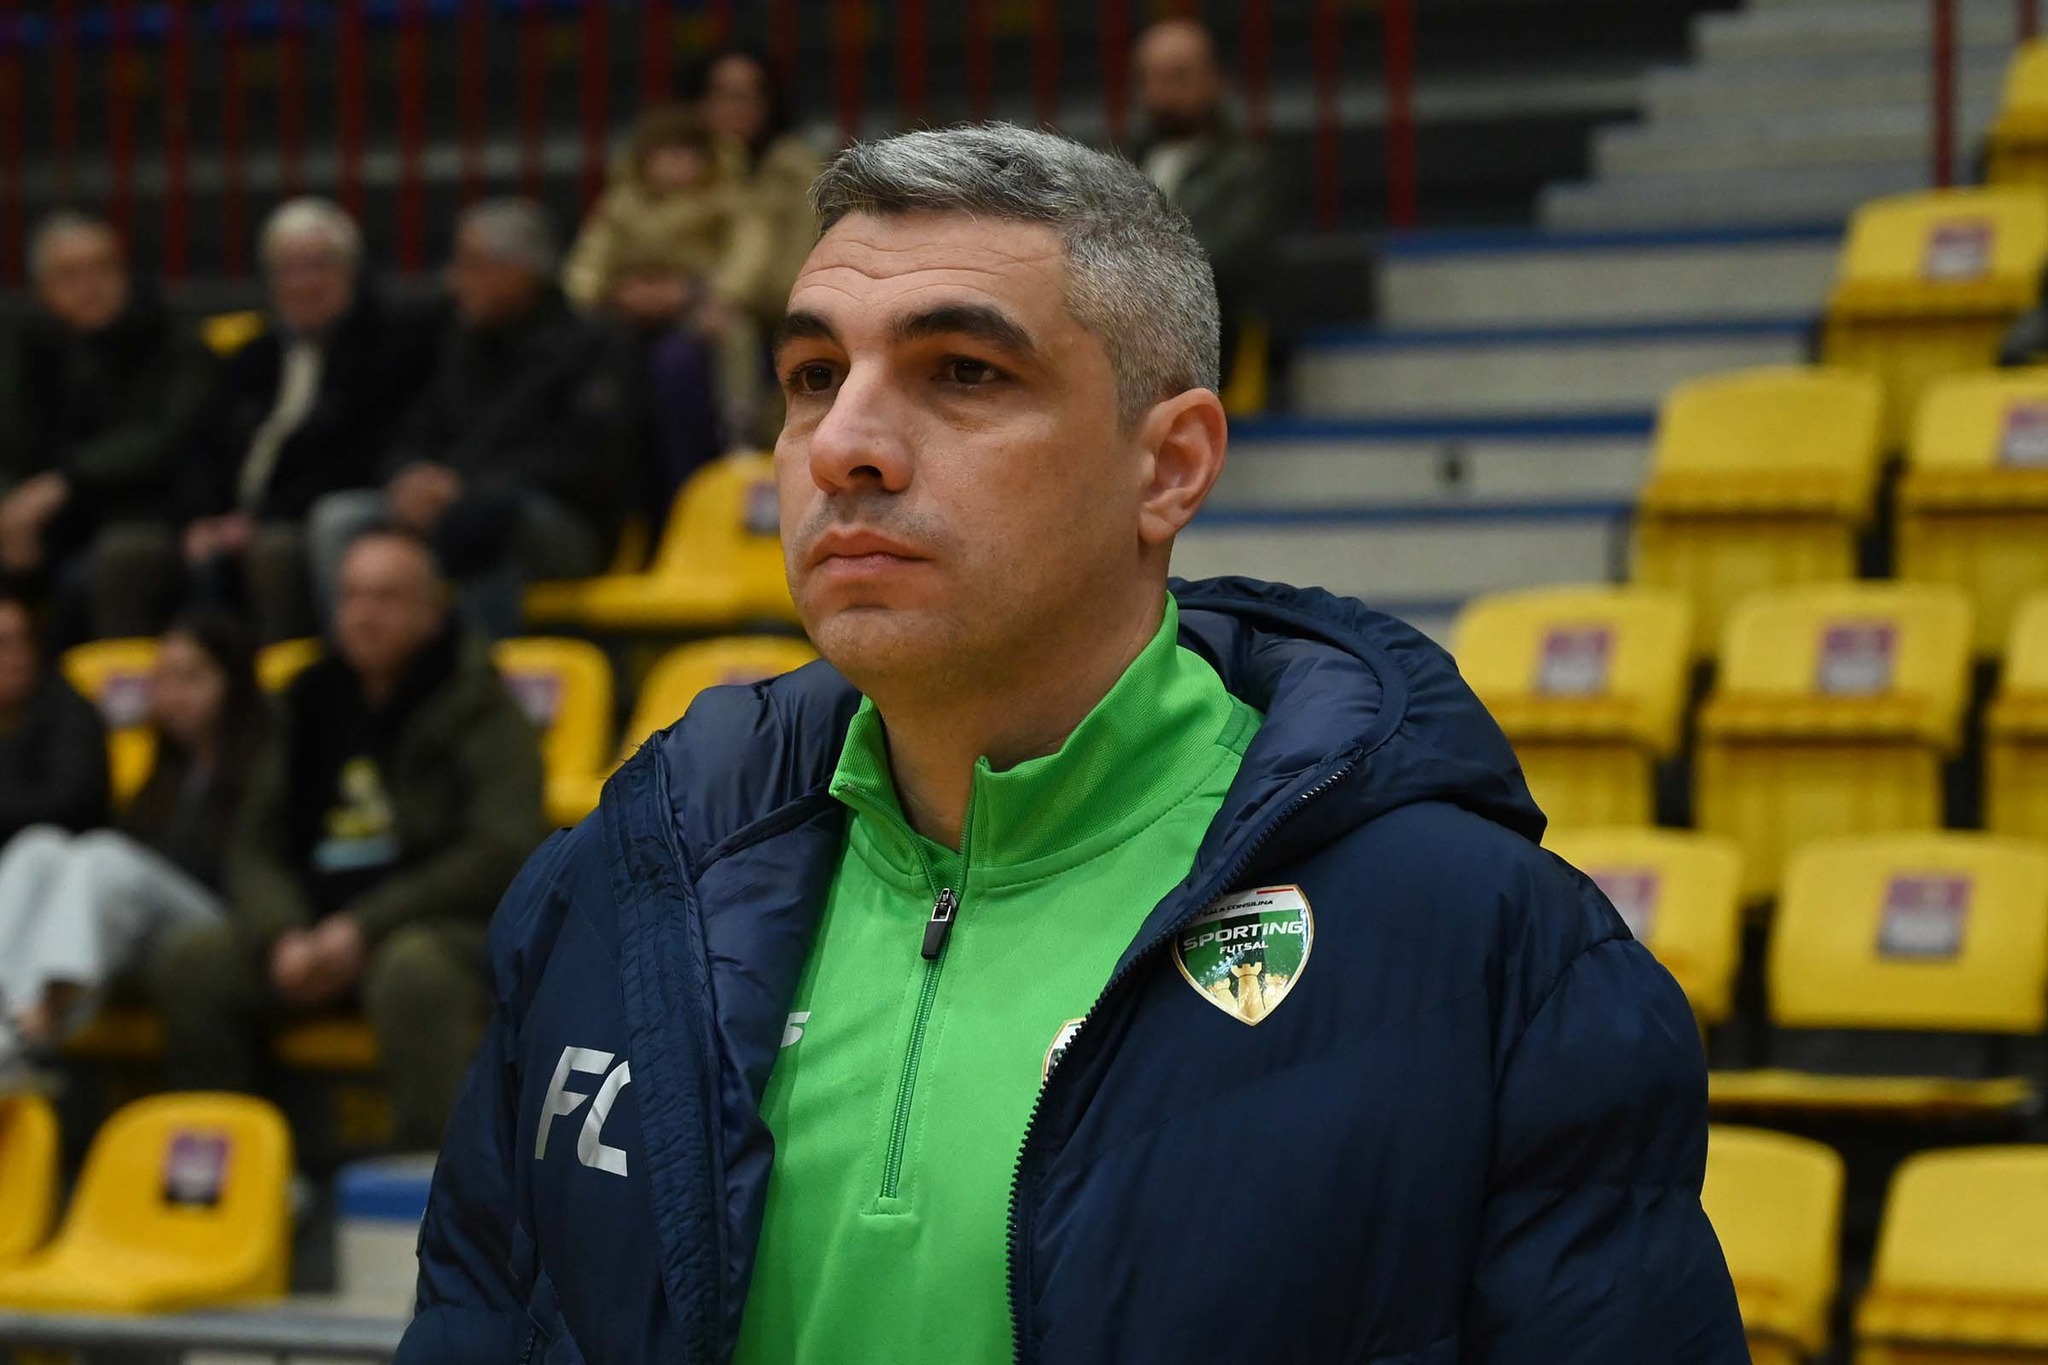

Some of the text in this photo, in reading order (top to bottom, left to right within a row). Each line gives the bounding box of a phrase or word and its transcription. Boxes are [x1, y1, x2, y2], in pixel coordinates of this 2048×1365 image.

[1227, 900, 1274, 911] CONSILINA
[1183, 921, 1304, 951] SPORTING
[1220, 940, 1269, 954] FUTSAL
[534, 1046, 631, 1177] FC
